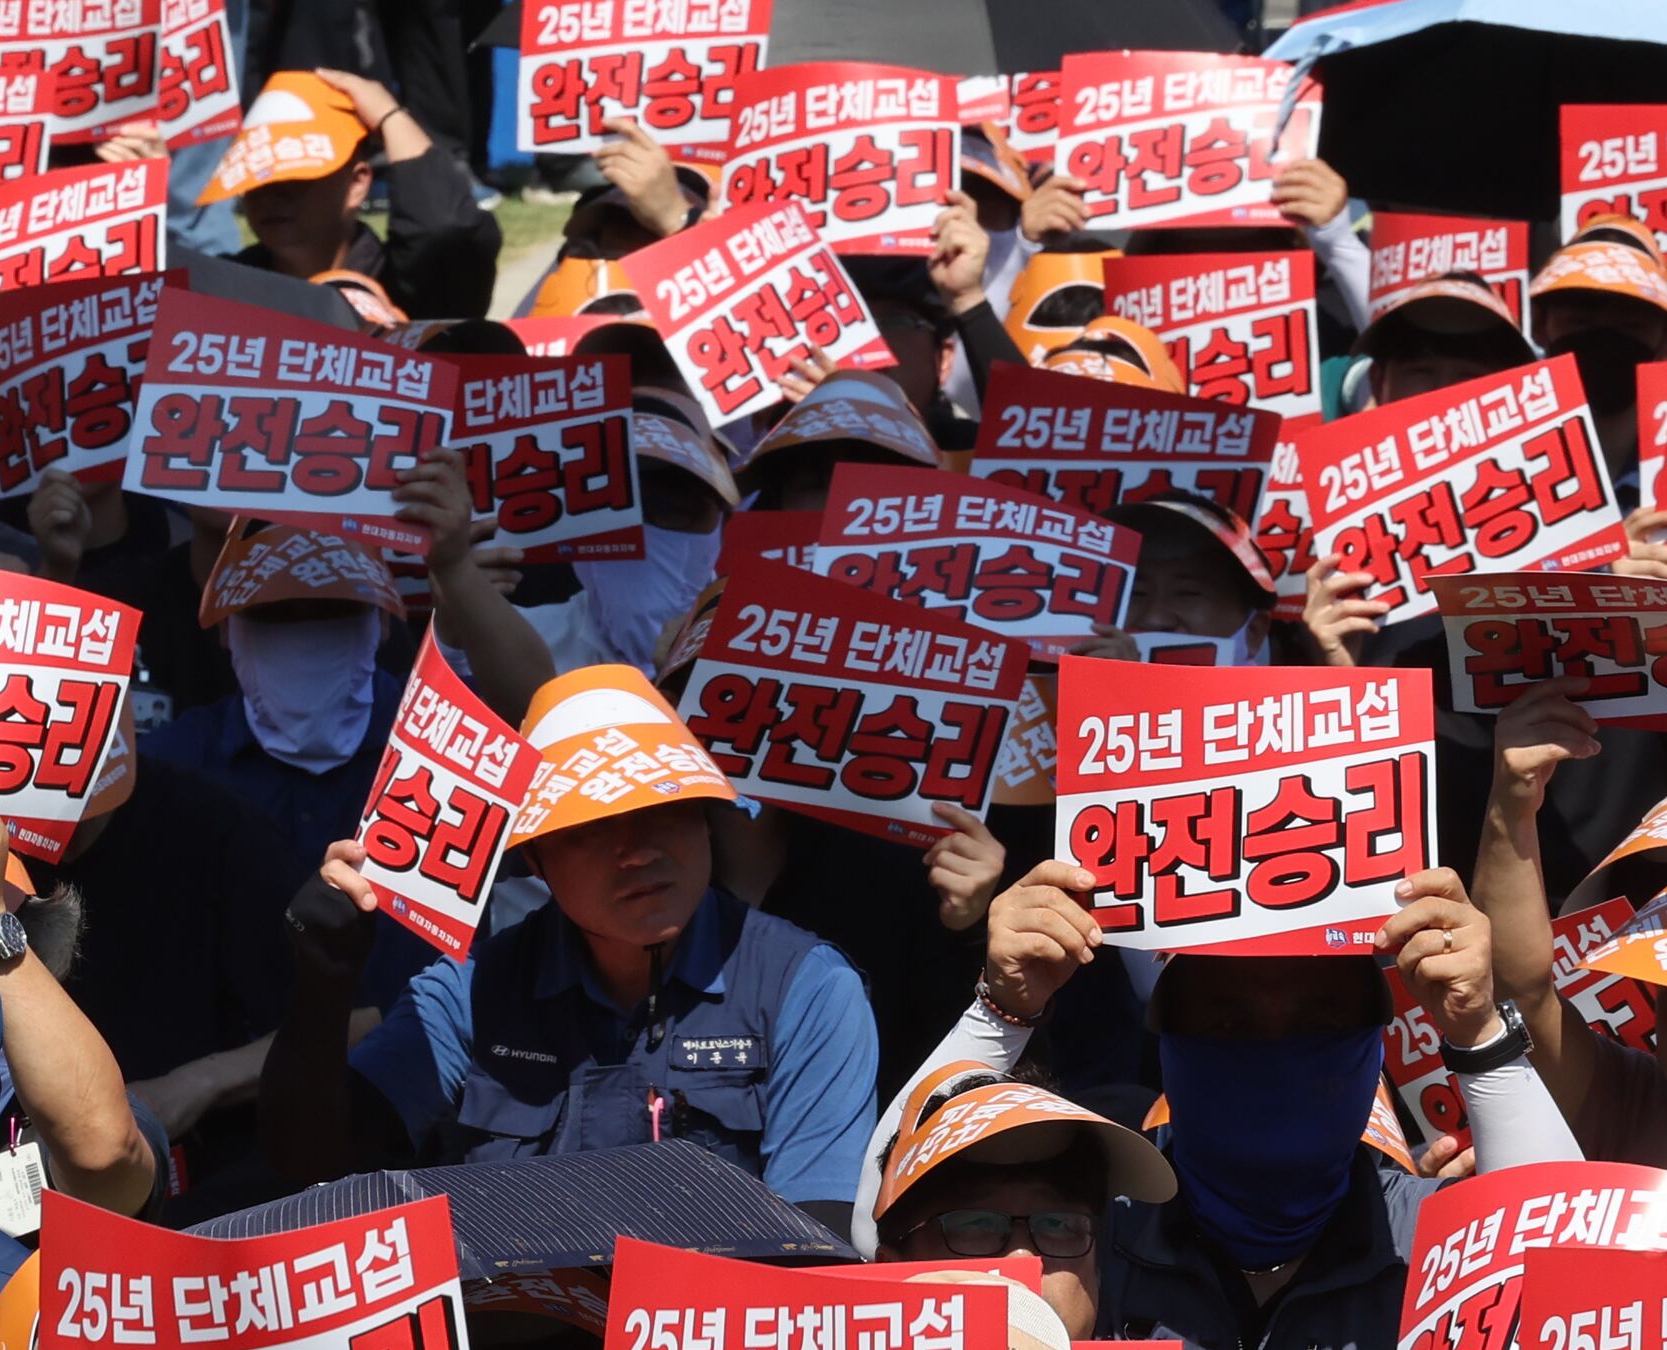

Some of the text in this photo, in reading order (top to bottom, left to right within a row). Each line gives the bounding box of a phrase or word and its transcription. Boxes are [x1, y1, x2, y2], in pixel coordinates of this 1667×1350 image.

[531, 42, 756, 144] 완전승리
[276, 340, 434, 399] 단체교섭
[685, 248, 857, 415] 완전승리
[140, 394, 443, 496] 완전승리
[1318, 443, 1405, 513] 25년
[1408, 369, 1559, 468] 단체교섭
[362, 522, 423, 546] 현대자동차지부
[951, 497, 1114, 553] 단체교섭
[729, 606, 1004, 691] 25년 단체교섭
[411, 685, 518, 782] 단체교섭
[687, 671, 1008, 810] 완전승리
[1078, 678, 1400, 775] 25년 단체교섭
[19, 824, 61, 854] 현대자동차지부
[1069, 752, 1428, 933] 완전승리
[409, 908, 462, 950] 현대자동차지부
[511, 1050, 557, 1064] HYUNDAI
[56, 1218, 413, 1345] 25년 단체교섭
[1417, 1208, 1505, 1303] 25년
